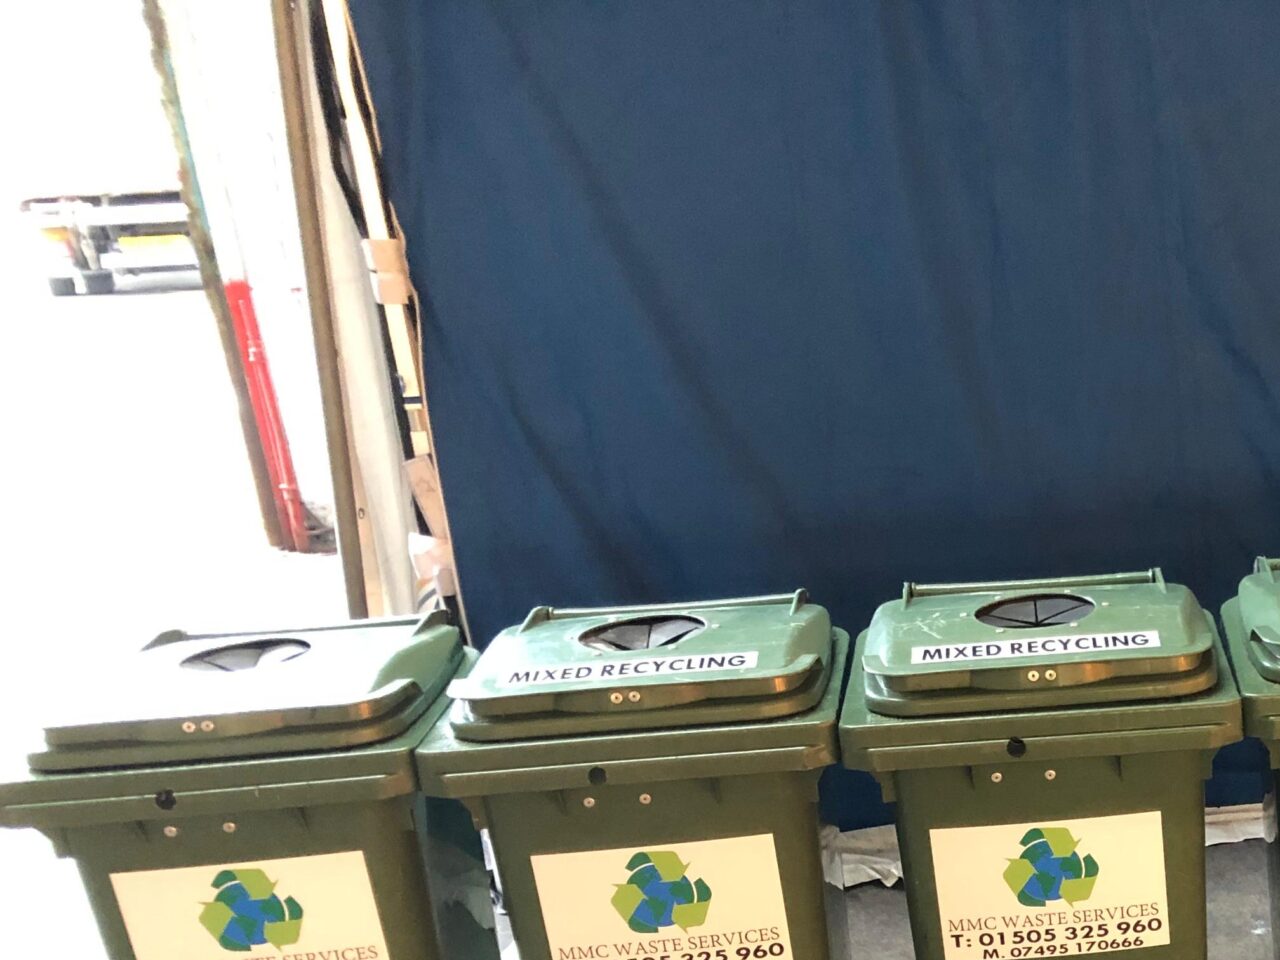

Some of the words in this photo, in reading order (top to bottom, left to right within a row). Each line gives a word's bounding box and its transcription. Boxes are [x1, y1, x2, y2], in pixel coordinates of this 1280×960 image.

[922, 644, 1002, 661] MIXED
[1010, 634, 1150, 654] RECYCLING
[508, 666, 593, 683] MIXED
[600, 655, 746, 676] RECYCLING
[948, 916, 997, 932] MMC
[1001, 909, 1068, 927] WASTE
[1072, 902, 1159, 923] SERVICES
[559, 944, 609, 960] MMC
[613, 938, 684, 956] WASTE
[688, 926, 780, 950] SERVICES
[951, 934, 972, 948] T:
[979, 928, 1056, 947] 01505
[1065, 923, 1109, 940] 325
[1117, 917, 1162, 935] 960
[735, 942, 785, 960] 960
[983, 949, 1005, 960] M.
[1010, 943, 1069, 958] 07495
[1075, 936, 1144, 953] 170666
